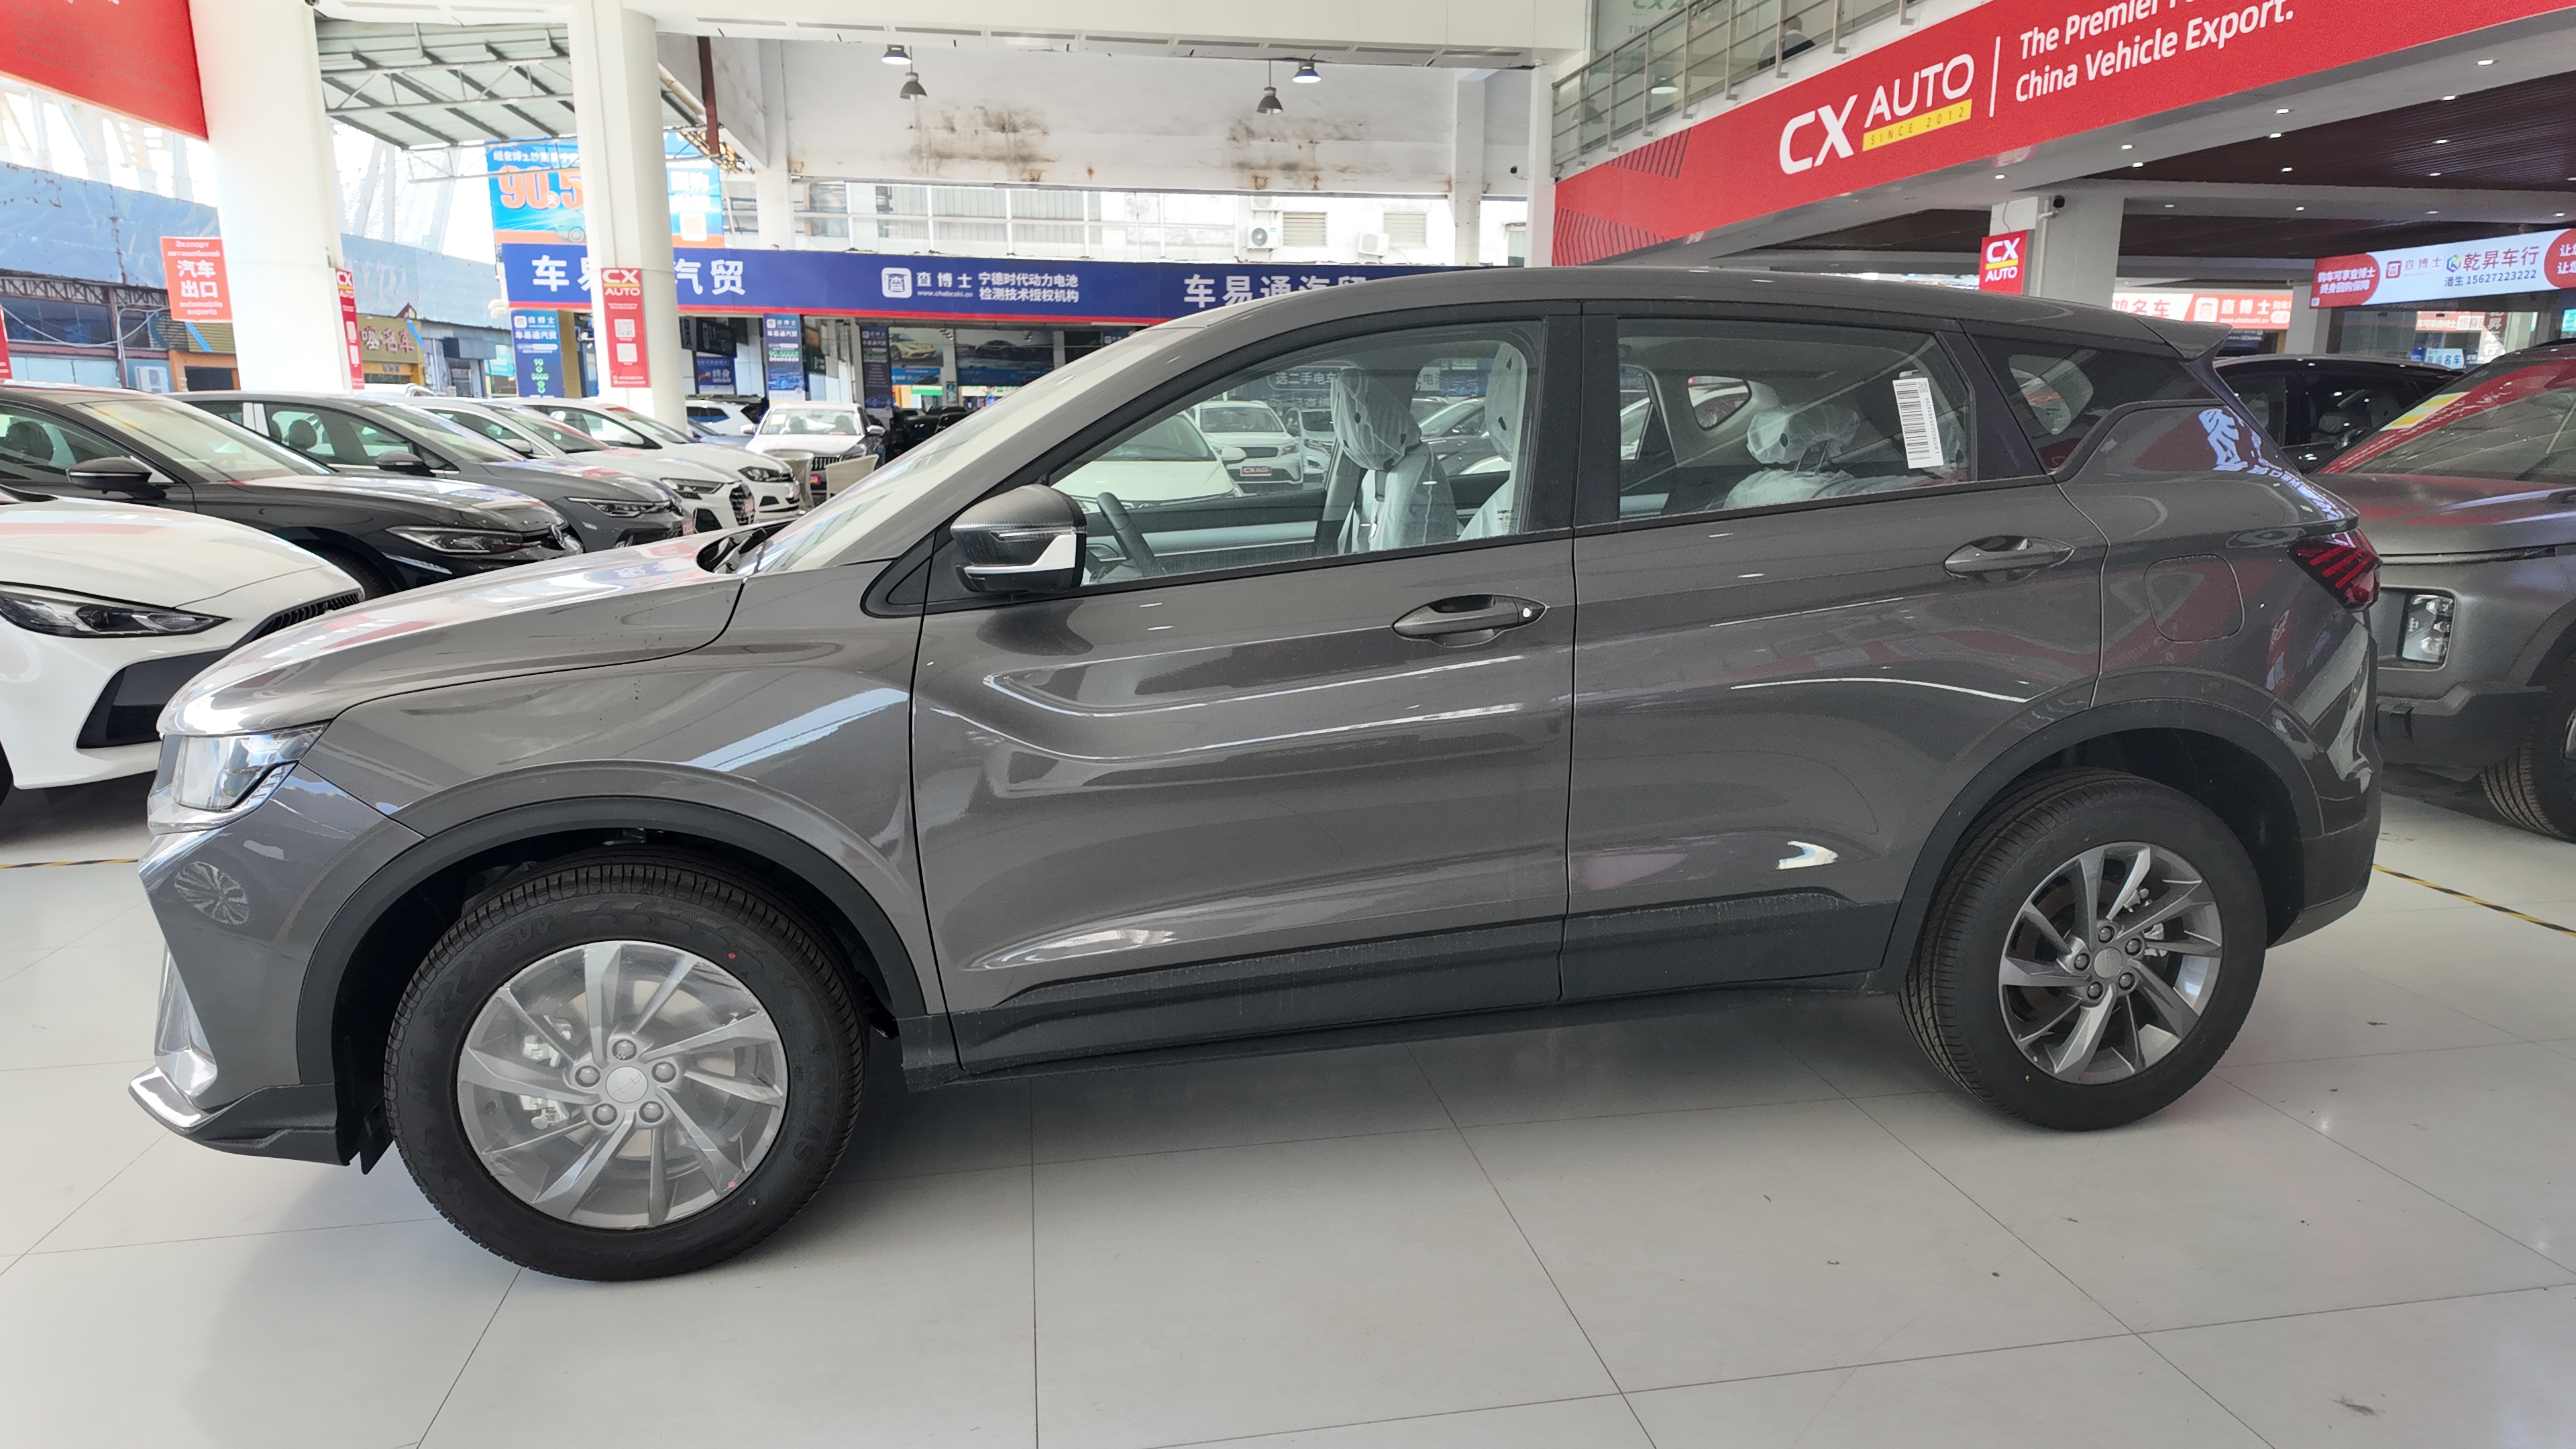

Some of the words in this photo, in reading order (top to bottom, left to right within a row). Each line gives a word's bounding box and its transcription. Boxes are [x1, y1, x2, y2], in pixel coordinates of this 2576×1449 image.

[2020, 27, 2059, 60] The
[2065, 0, 2158, 44] Premier
[2015, 64, 2078, 102] China
[2085, 28, 2178, 80] Vehicle
[2186, 0, 2294, 51] Export.
[1779, 94, 1858, 174] CX
[1864, 53, 1975, 129] AUTO
[1870, 123, 1913, 146] SINCE
[1926, 106, 1965, 128] 2012
[175, 240, 210, 248] Экспорт
[1986, 237, 2021, 263] CX
[2405, 257, 2442, 270] 查博士
[2463, 246, 2540, 272] 乾昇车行
[176, 260, 216, 278] 汽车
[602, 269, 640, 283] CX
[1985, 266, 2018, 282] AUTO
[2318, 266, 2375, 283] 购车可享查博士
[337, 271, 353, 286] CX
[916, 271, 973, 288] 查博士
[978, 270, 1079, 287] 宁德时代动力电池
[2320, 279, 2370, 294] 终身回购保障
[2445, 275, 2464, 287] 潘生
[2466, 270, 2536, 284] 15627223222
[180, 280, 218, 298] 出口
[339, 290, 354, 299] AUTO
[605, 287, 641, 297] AUTO
[979, 288, 1079, 303] 检测技术授权机构
[2221, 299, 2271, 315] 查博士
